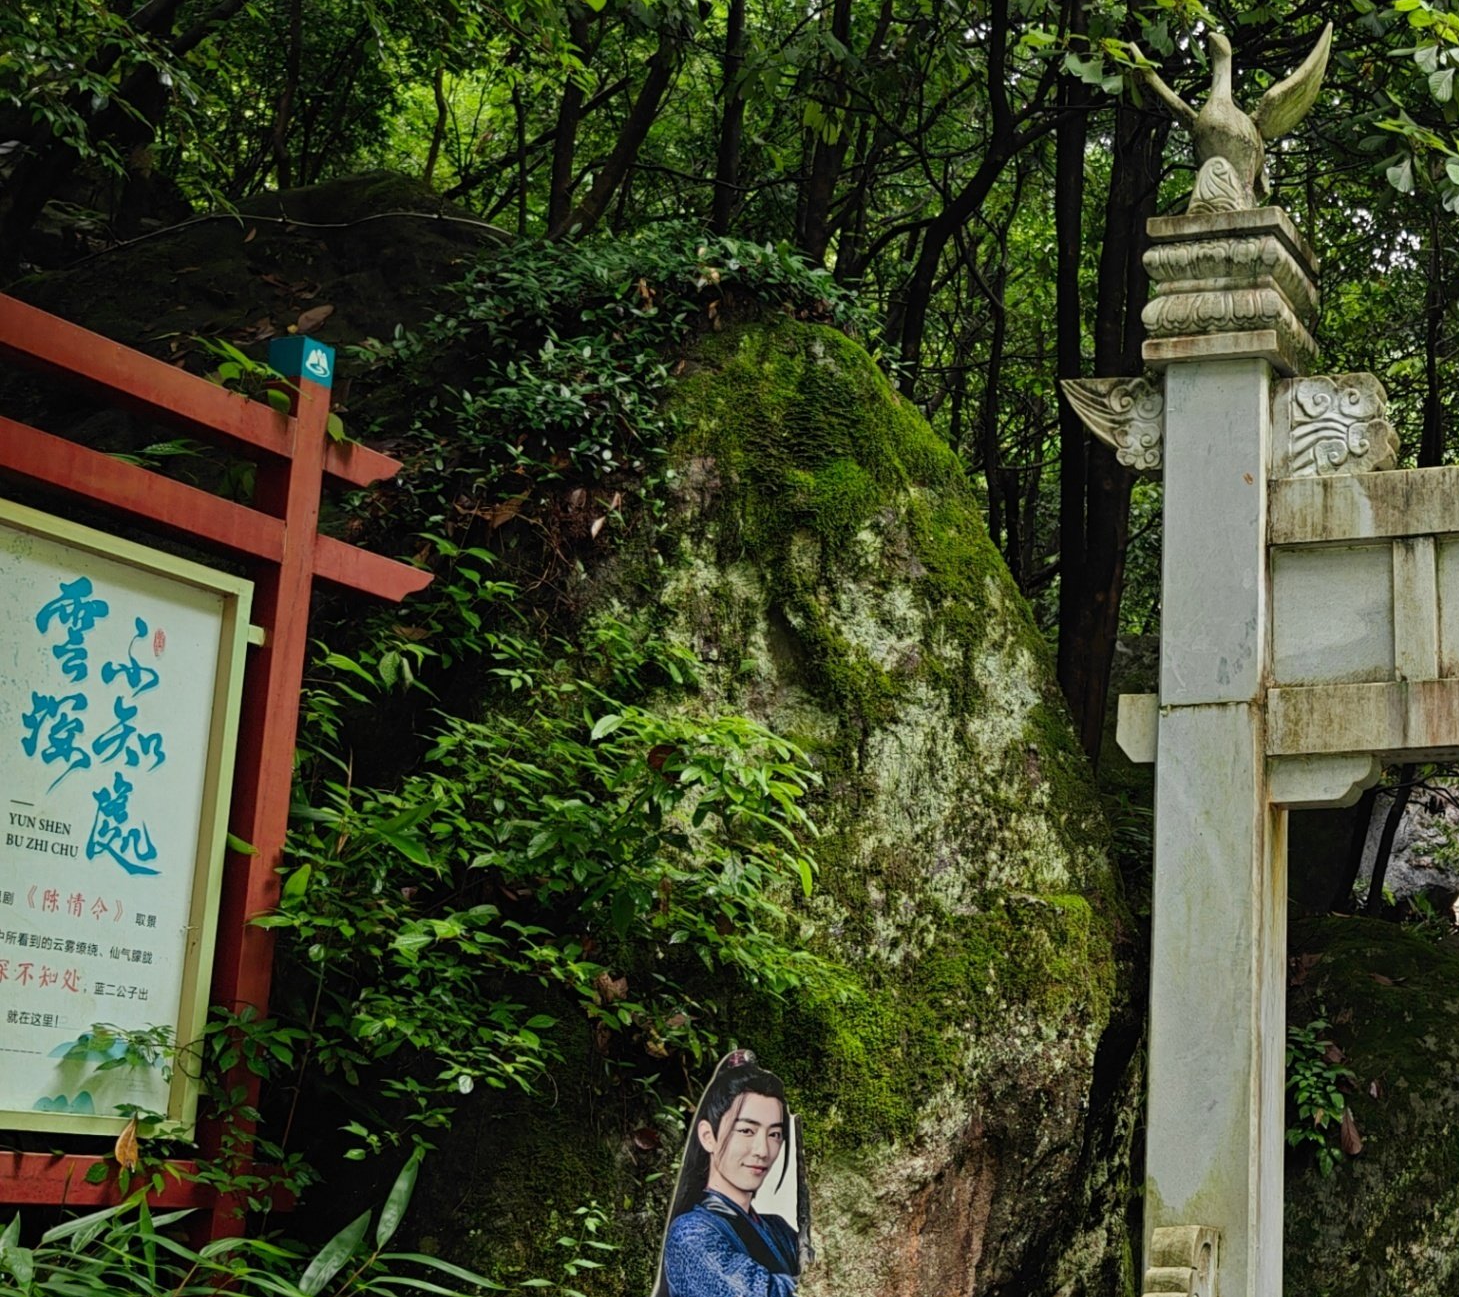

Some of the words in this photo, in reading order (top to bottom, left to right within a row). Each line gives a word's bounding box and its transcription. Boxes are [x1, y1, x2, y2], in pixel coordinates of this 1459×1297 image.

[9, 812, 36, 828] YUN
[38, 818, 72, 835] SHEN
[5, 833, 24, 847] BU
[25, 837, 48, 852] ZHI
[51, 842, 79, 857] CHU
